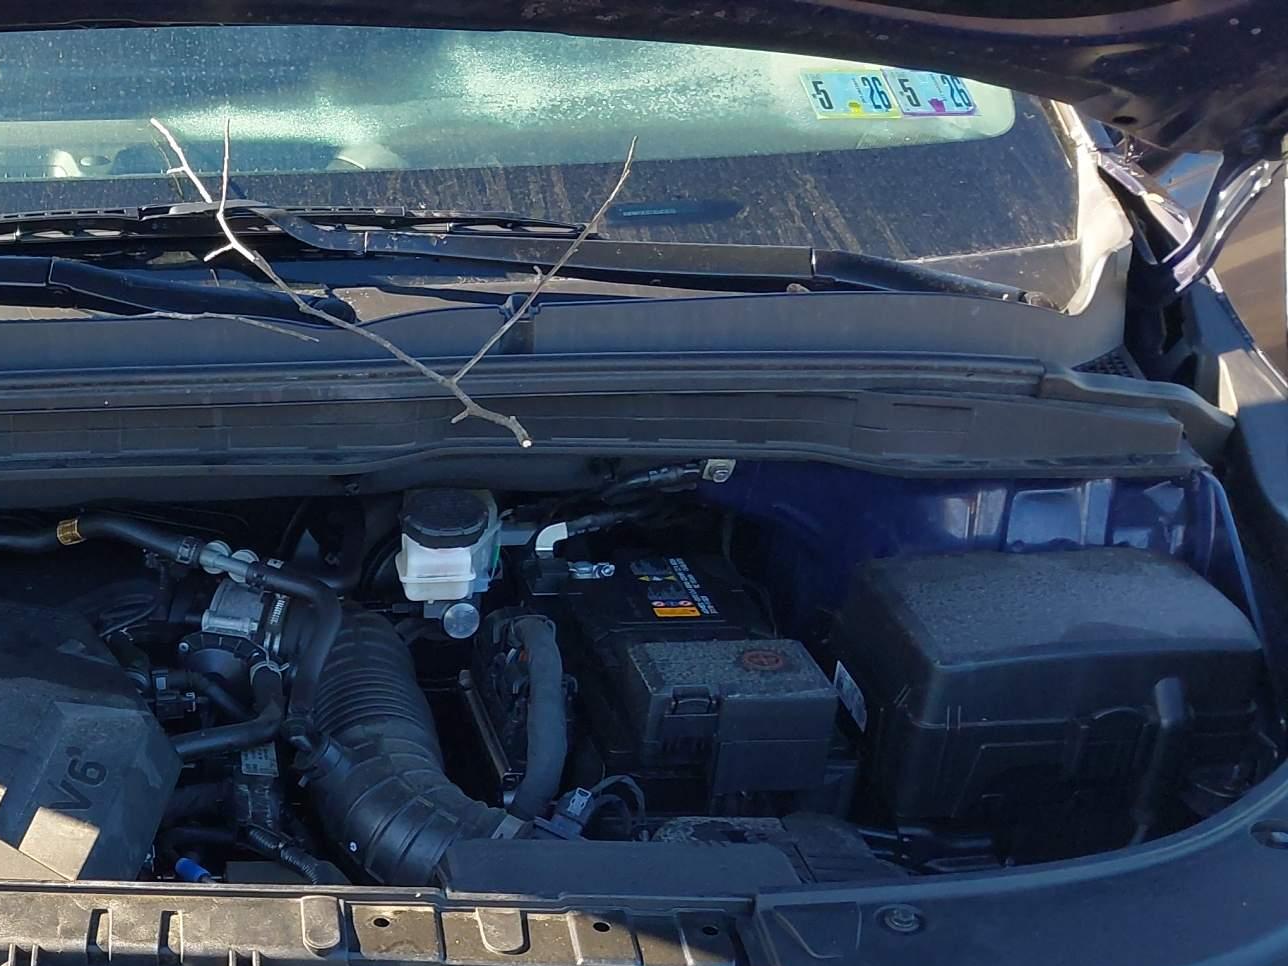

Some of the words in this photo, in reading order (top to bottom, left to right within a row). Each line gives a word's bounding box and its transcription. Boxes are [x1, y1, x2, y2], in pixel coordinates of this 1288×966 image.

[811, 80, 834, 110] 5
[860, 76, 892, 110] 26
[897, 78, 921, 107] 5
[940, 75, 973, 108] 26
[49, 757, 108, 811] V6
